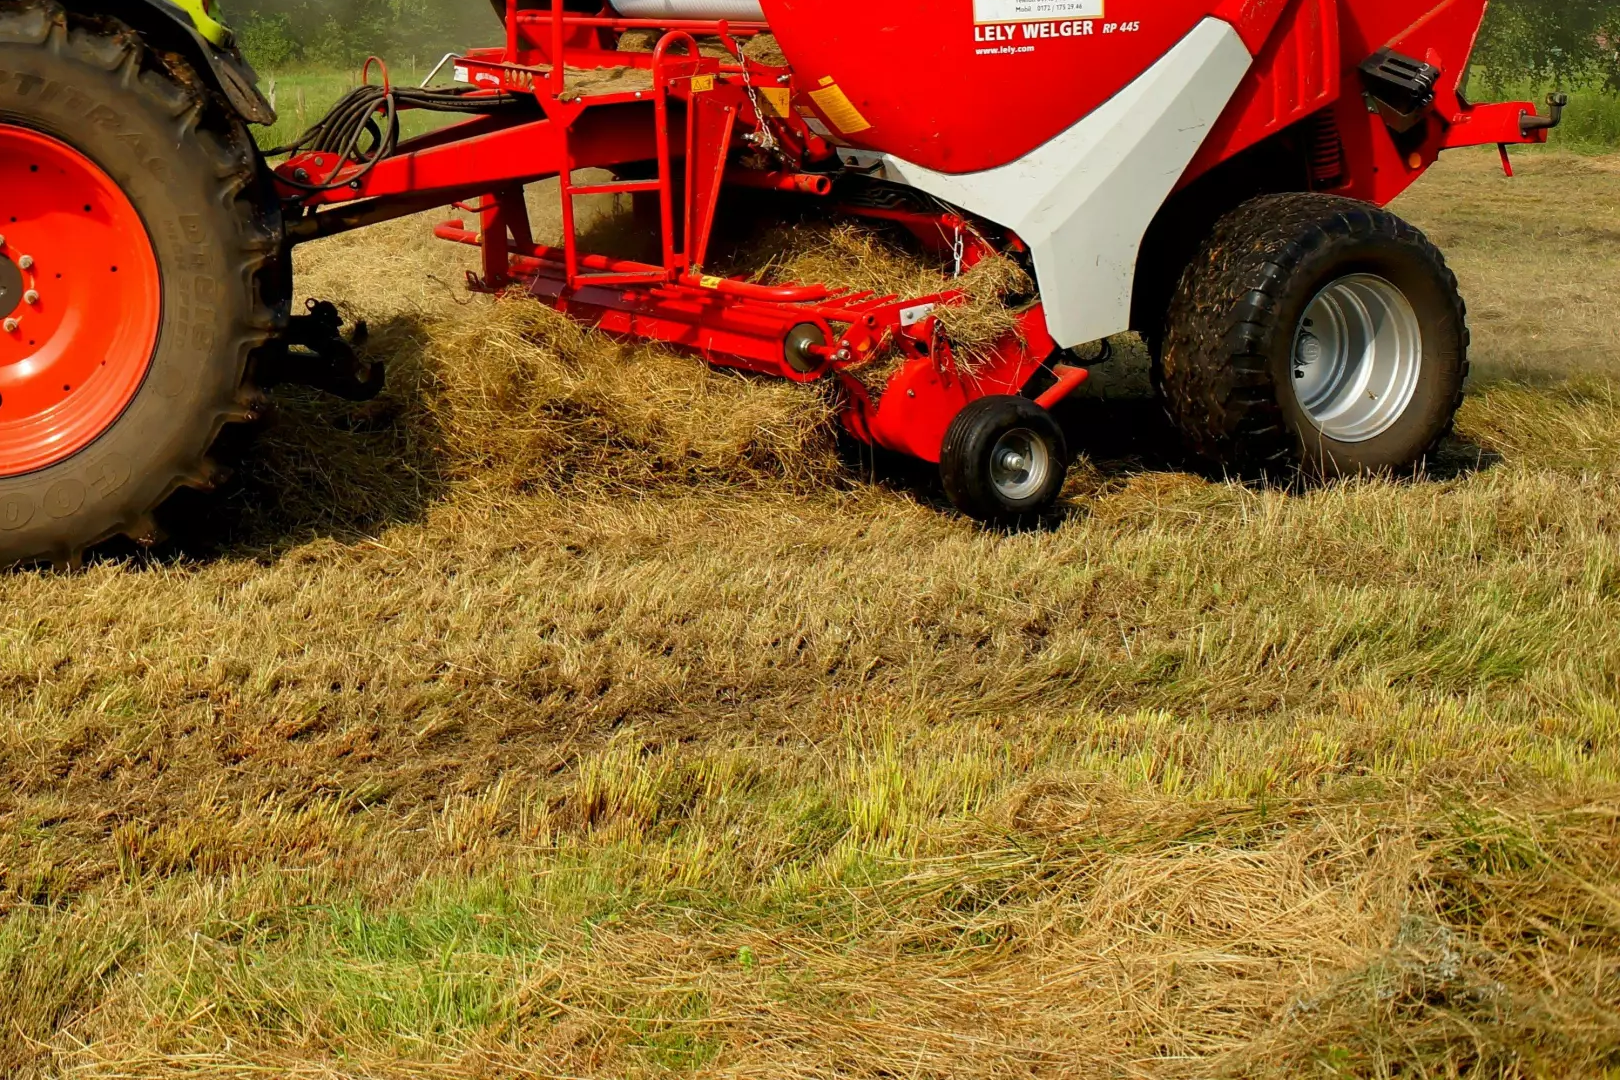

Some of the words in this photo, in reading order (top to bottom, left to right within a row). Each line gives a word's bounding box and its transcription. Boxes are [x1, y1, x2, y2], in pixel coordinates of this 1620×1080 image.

[1037, 4, 1051, 12] 0172
[974, 25, 1017, 42] LELY
[1022, 20, 1094, 39] WELGER
[1102, 22, 1118, 34] RP
[1119, 20, 1140, 32] 445
[975, 44, 1035, 56] www.lely.com
